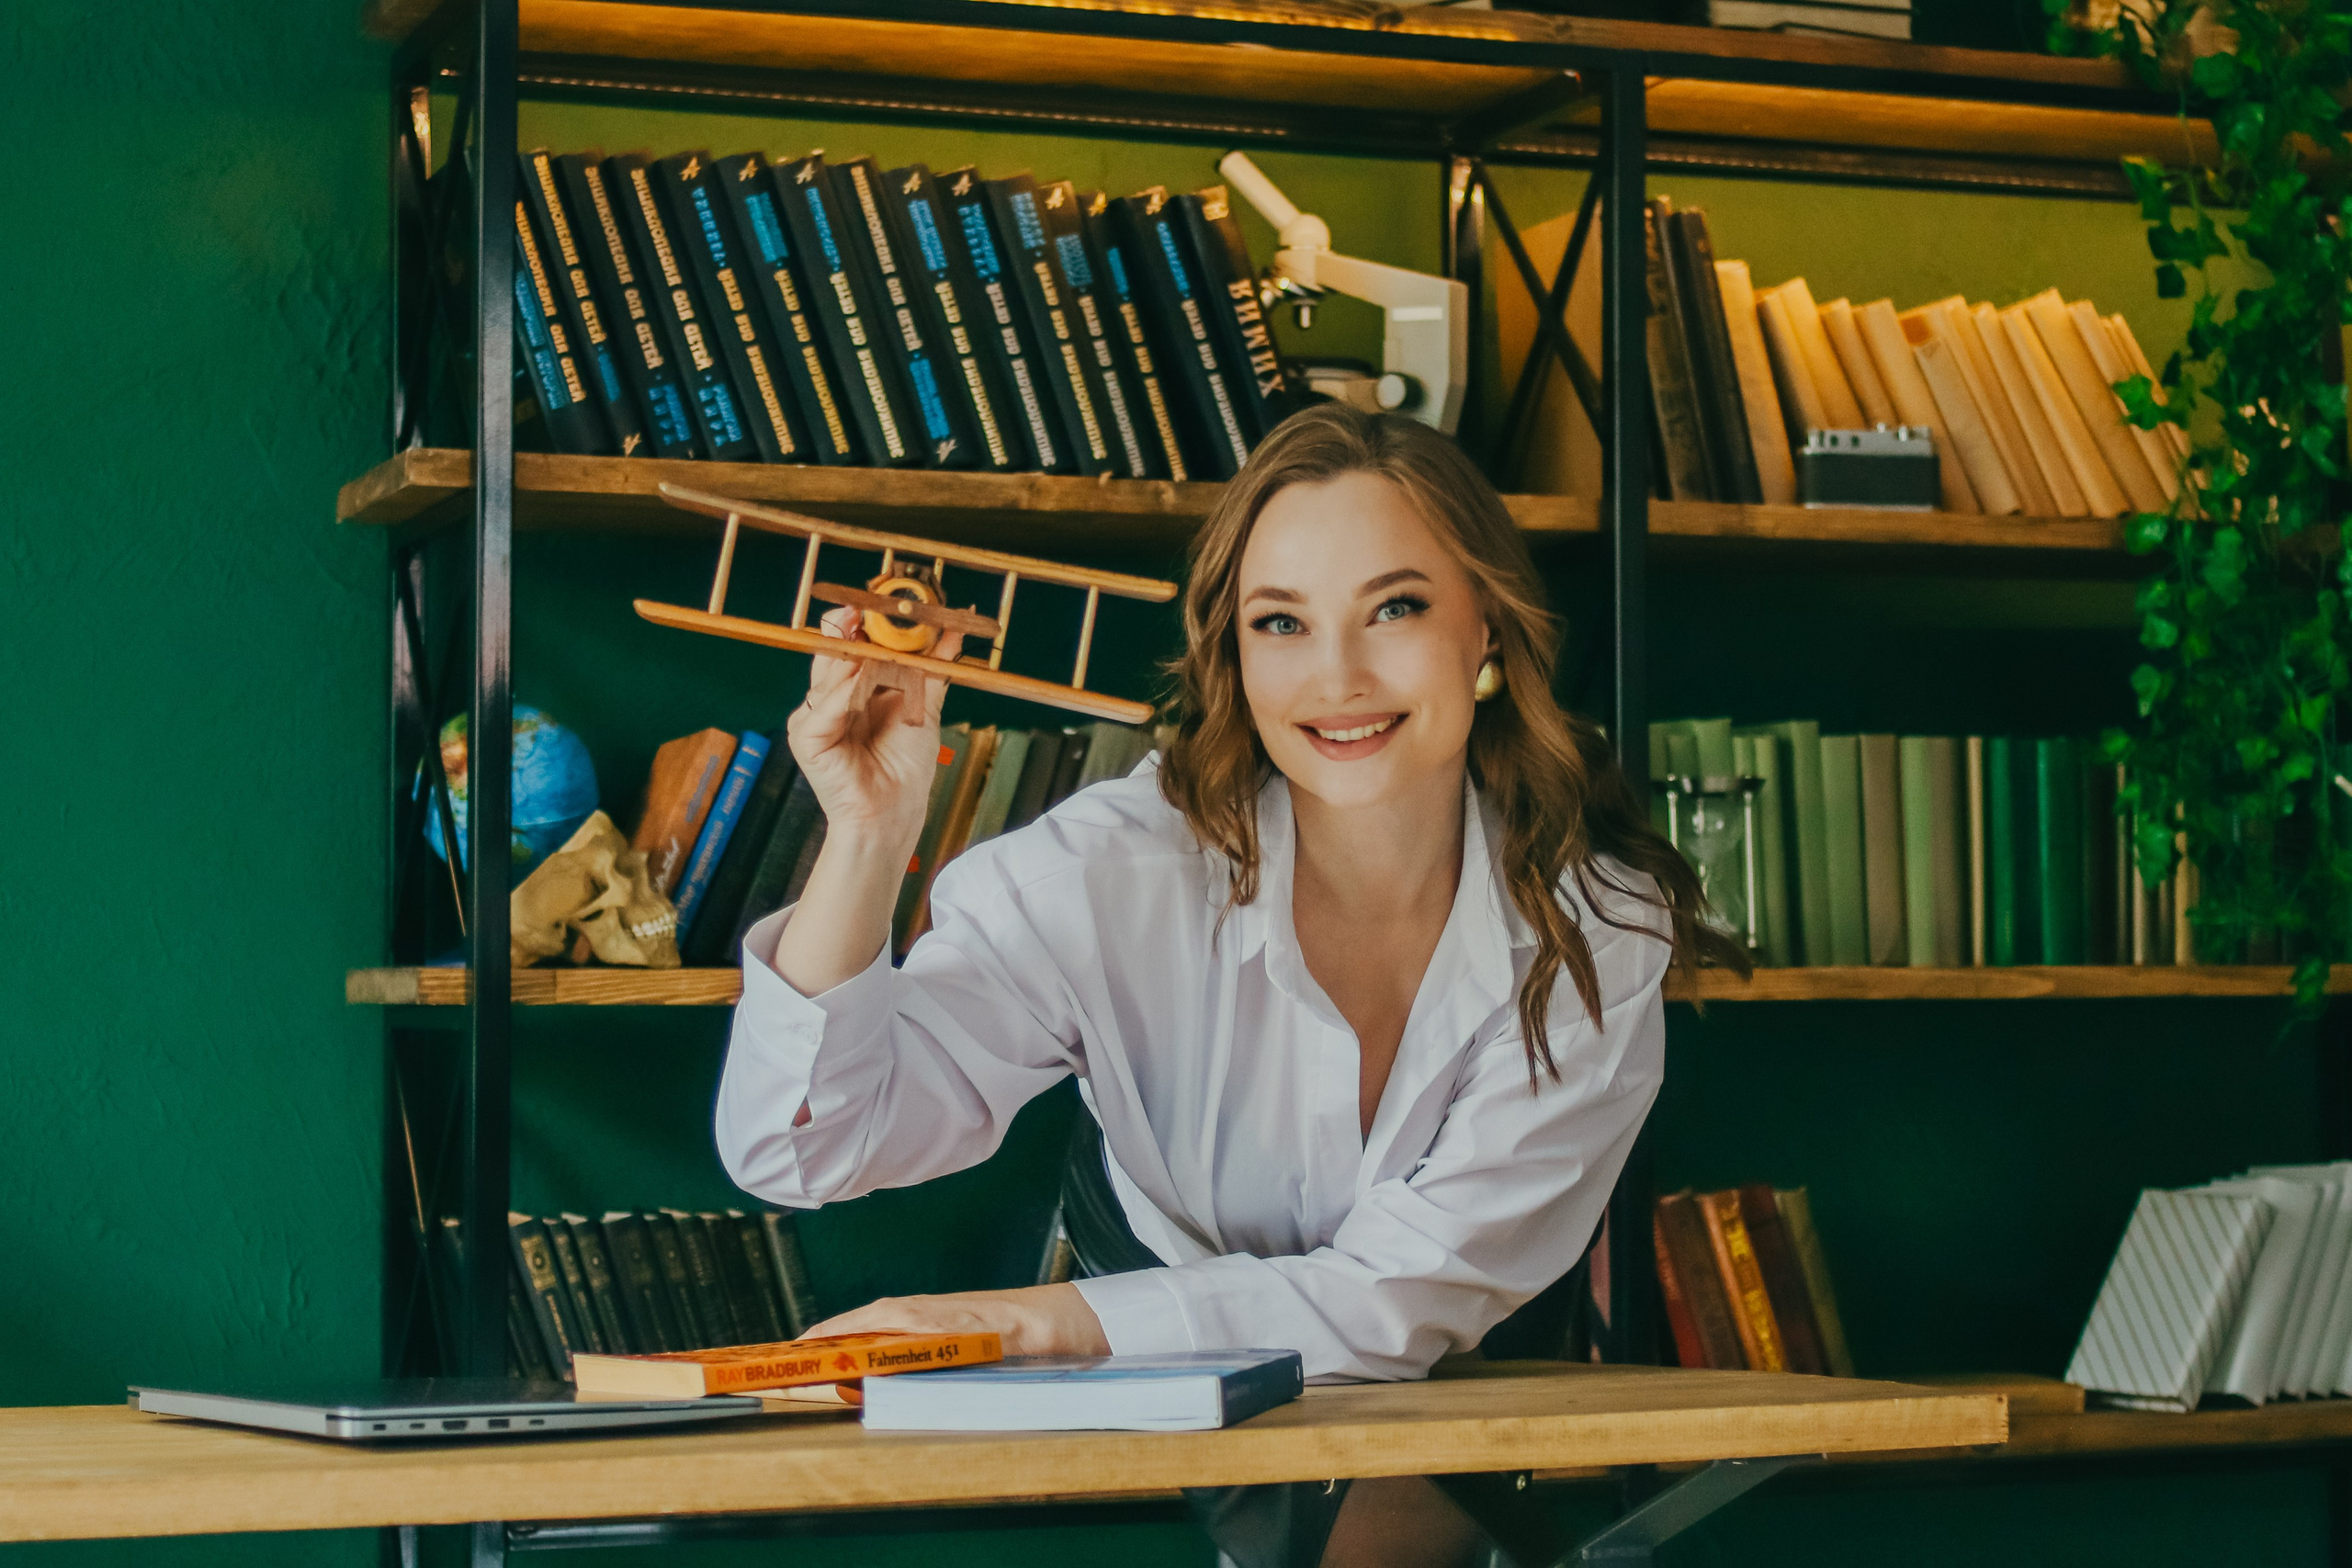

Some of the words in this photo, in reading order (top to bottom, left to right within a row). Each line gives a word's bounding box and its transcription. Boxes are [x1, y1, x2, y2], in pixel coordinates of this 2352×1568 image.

[717, 268, 744, 311] ДЕТЕЙ
[773, 269, 800, 311] ДЕТЕЙ
[829, 271, 856, 315] ДЕТЕЙ
[934, 281, 961, 323] ДЕТЕЙ
[985, 282, 1011, 324] ДЕТЕЙ
[1034, 262, 1059, 306] ДЕТЕЙ
[570, 269, 590, 299] ДЛЯ
[580, 300, 606, 344] ДЕТЕЙ
[672, 289, 695, 321] ДЛЯ
[886, 277, 906, 306] ДЛЯ
[896, 308, 922, 352] ДЕТЕЙ
[1050, 310, 1069, 340] ДЛЯ
[1079, 296, 1102, 336] ДЕТЕЙ
[1119, 303, 1143, 344] ДЕТЕЙ
[1182, 299, 1206, 340] ДЕТЕЙ
[624, 288, 645, 320] ДЛЯ
[635, 322, 663, 369] ДЕТЕЙ
[683, 322, 713, 372] ДЕТЕЙ
[734, 313, 755, 343] ДЛЯ
[790, 313, 810, 343] ДЛЯ
[845, 317, 866, 345] ДЛЯ
[950, 326, 971, 355] ДЛЯ
[1001, 327, 1021, 355] ДЛЯ
[1227, 278, 1285, 399] ХИМИЯ
[549, 323, 569, 354] ДЛЯ
[560, 356, 586, 403] ДЕТЕЙ
[1093, 340, 1112, 367] ДЛЯ
[1135, 346, 1152, 373] ДЛЯ
[1198, 344, 1216, 370] ДЛЯ
[866, 1347, 933, 1368] Fahrenheit
[936, 1344, 959, 1361] 451
